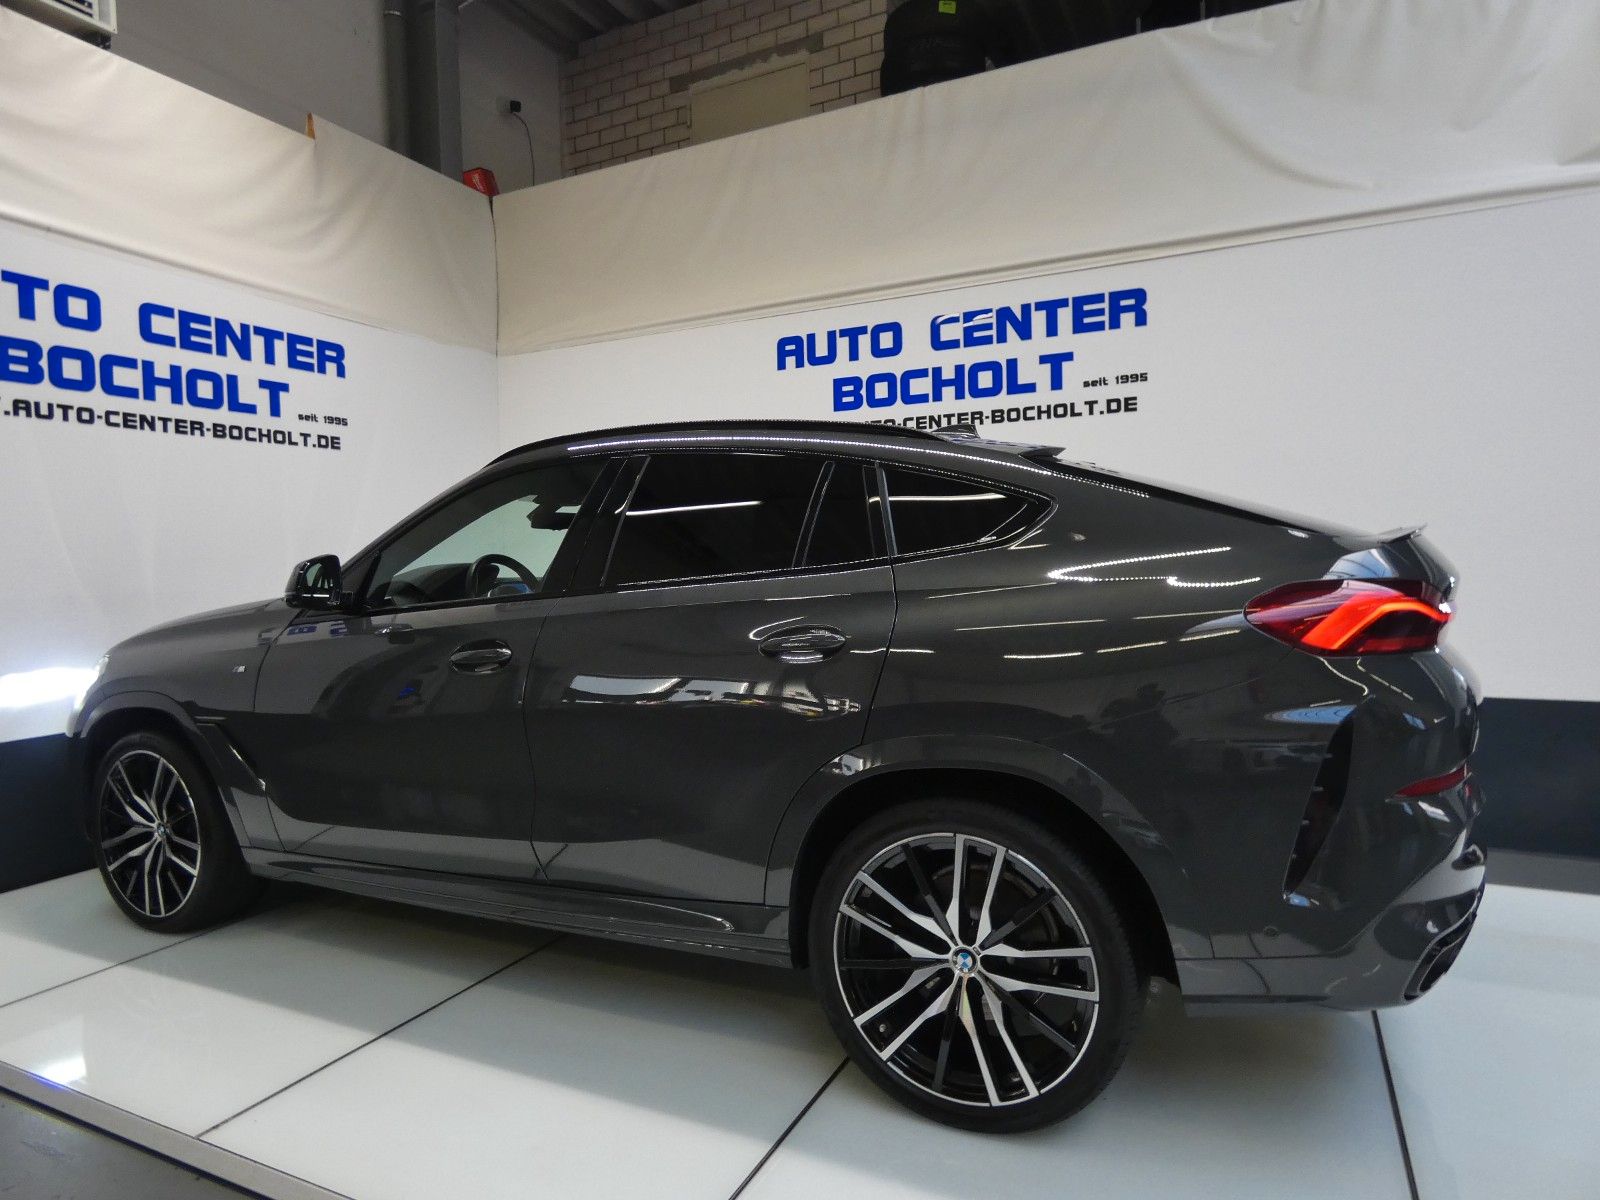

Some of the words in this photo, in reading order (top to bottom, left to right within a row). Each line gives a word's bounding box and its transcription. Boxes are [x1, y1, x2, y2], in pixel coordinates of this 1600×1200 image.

[138, 302, 347, 379] CENTER
[776, 321, 904, 371] AUTO
[930, 287, 1148, 352] CENTER
[0, 335, 290, 418] BOCHOLT
[832, 351, 1075, 413] BOCHOLT
[1082, 376, 1109, 388] seit
[1115, 372, 1149, 385] 1995
[0, 397, 342, 451] .AUTO-CENTER-BOCHOLT.DE
[297, 413, 319, 423] seit
[323, 415, 349, 427] 1995
